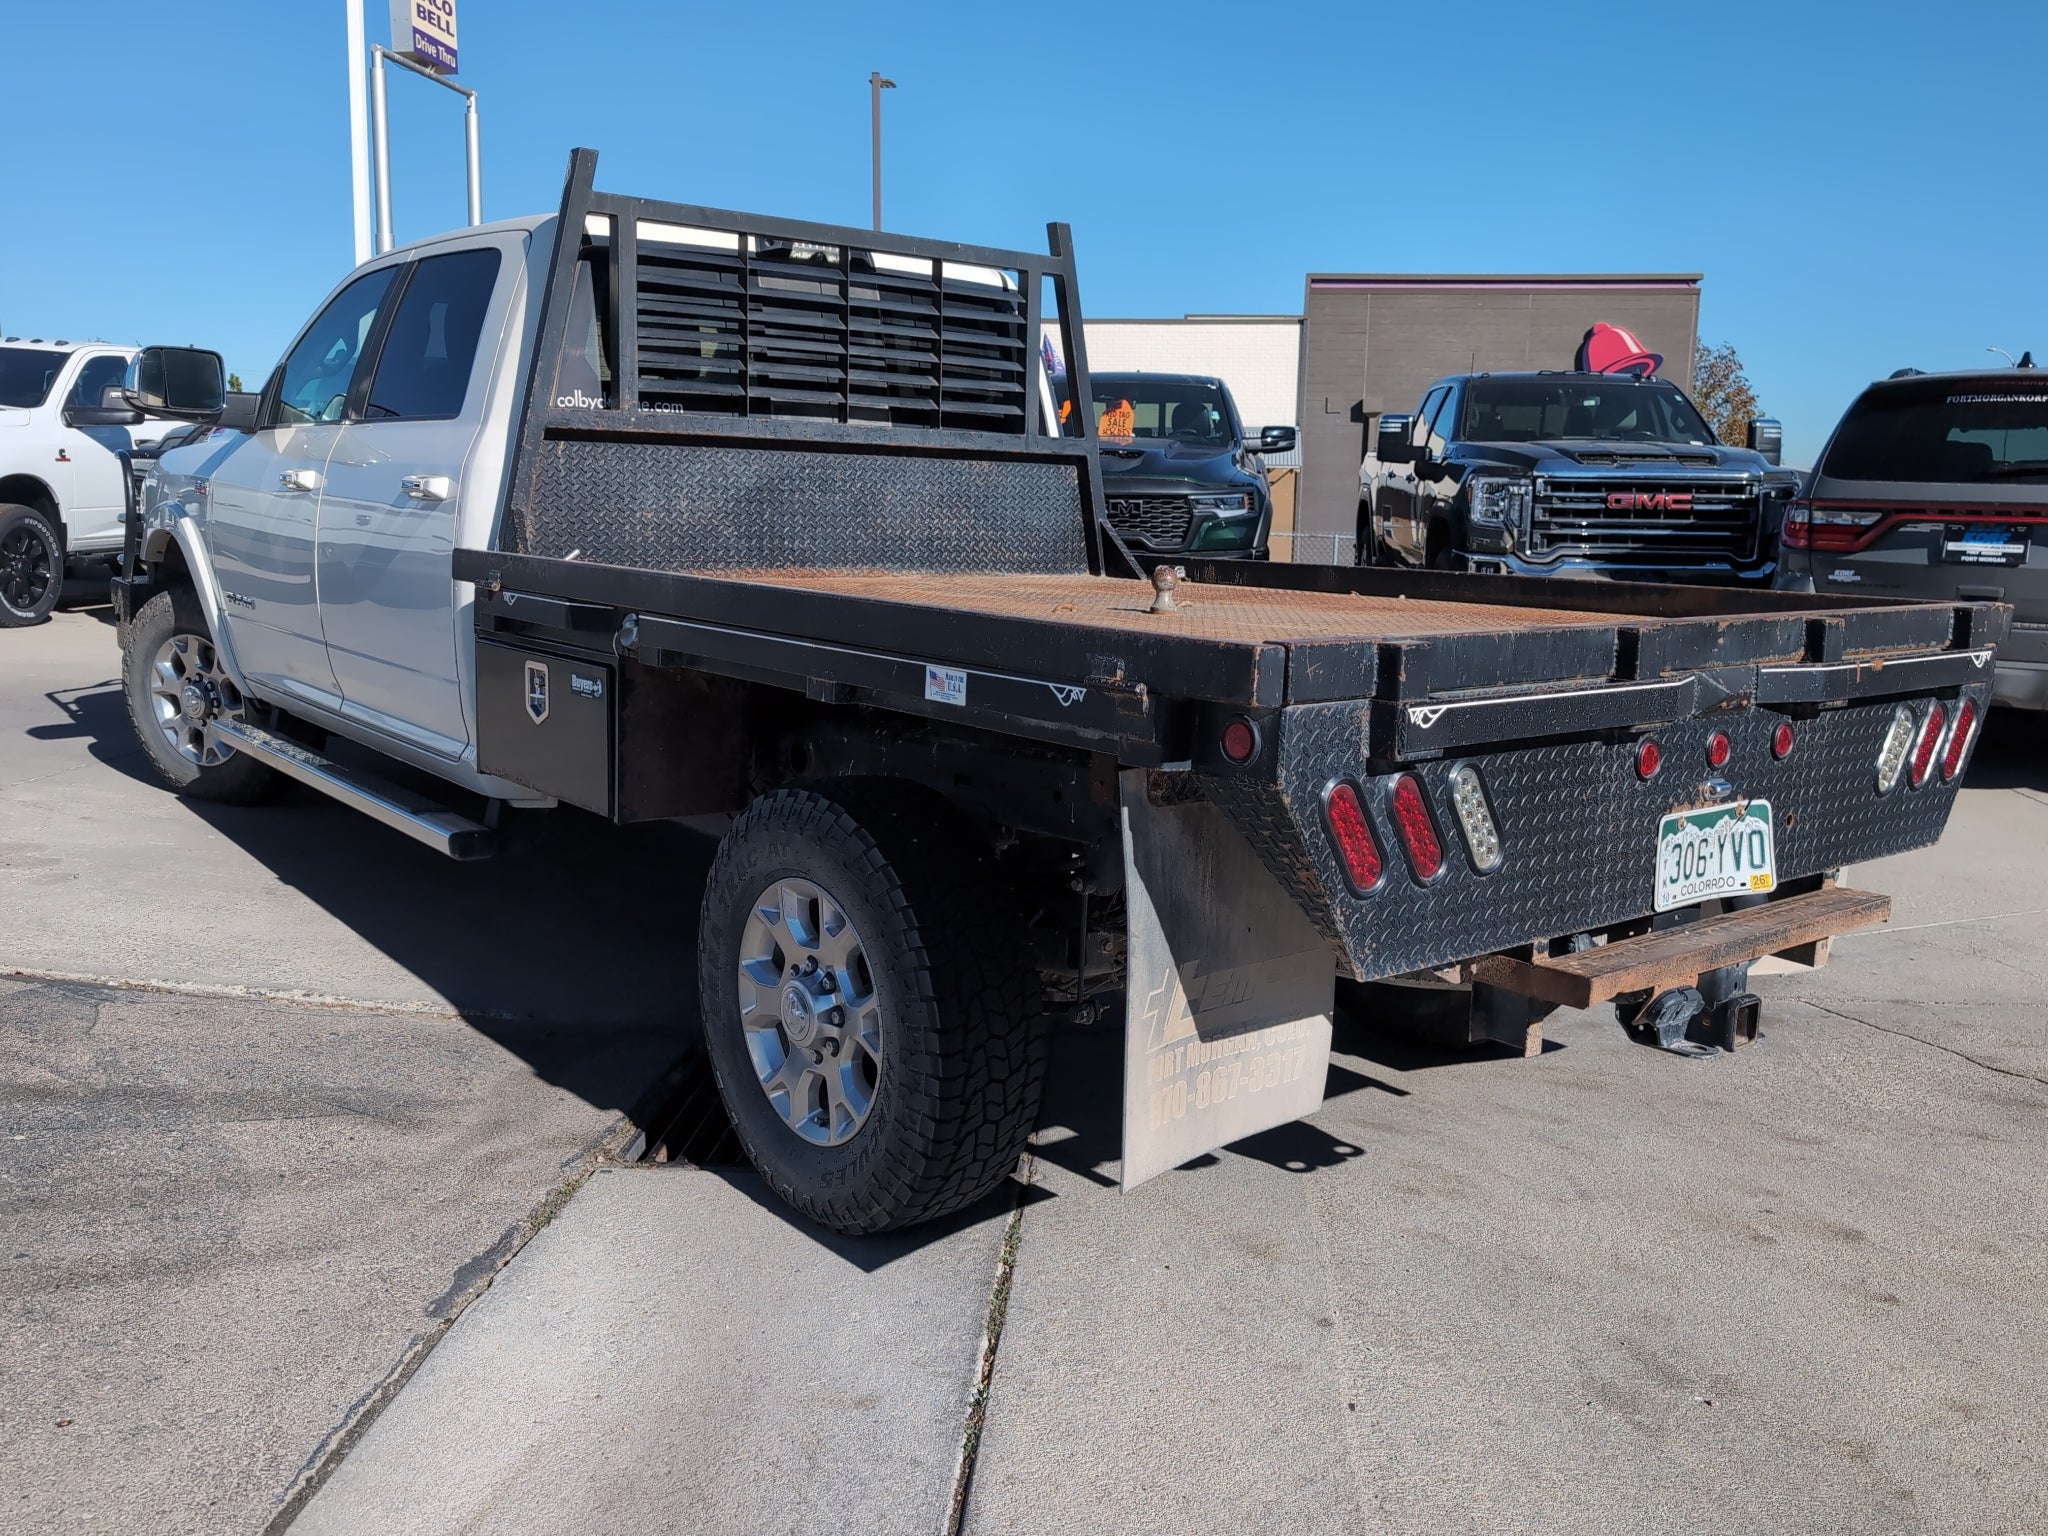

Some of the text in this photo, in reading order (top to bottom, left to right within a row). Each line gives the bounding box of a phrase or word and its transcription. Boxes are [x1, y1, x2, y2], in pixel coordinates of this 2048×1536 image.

[416, 3, 455, 38] BELL
[415, 33, 456, 68] Drive Thru
[1107, 417, 1127, 428] SALE
[1118, 411, 1131, 419] TAG
[1607, 493, 1693, 510] GMC
[1681, 876, 1736, 897] COLORADO
[1752, 874, 1766, 886] 26
